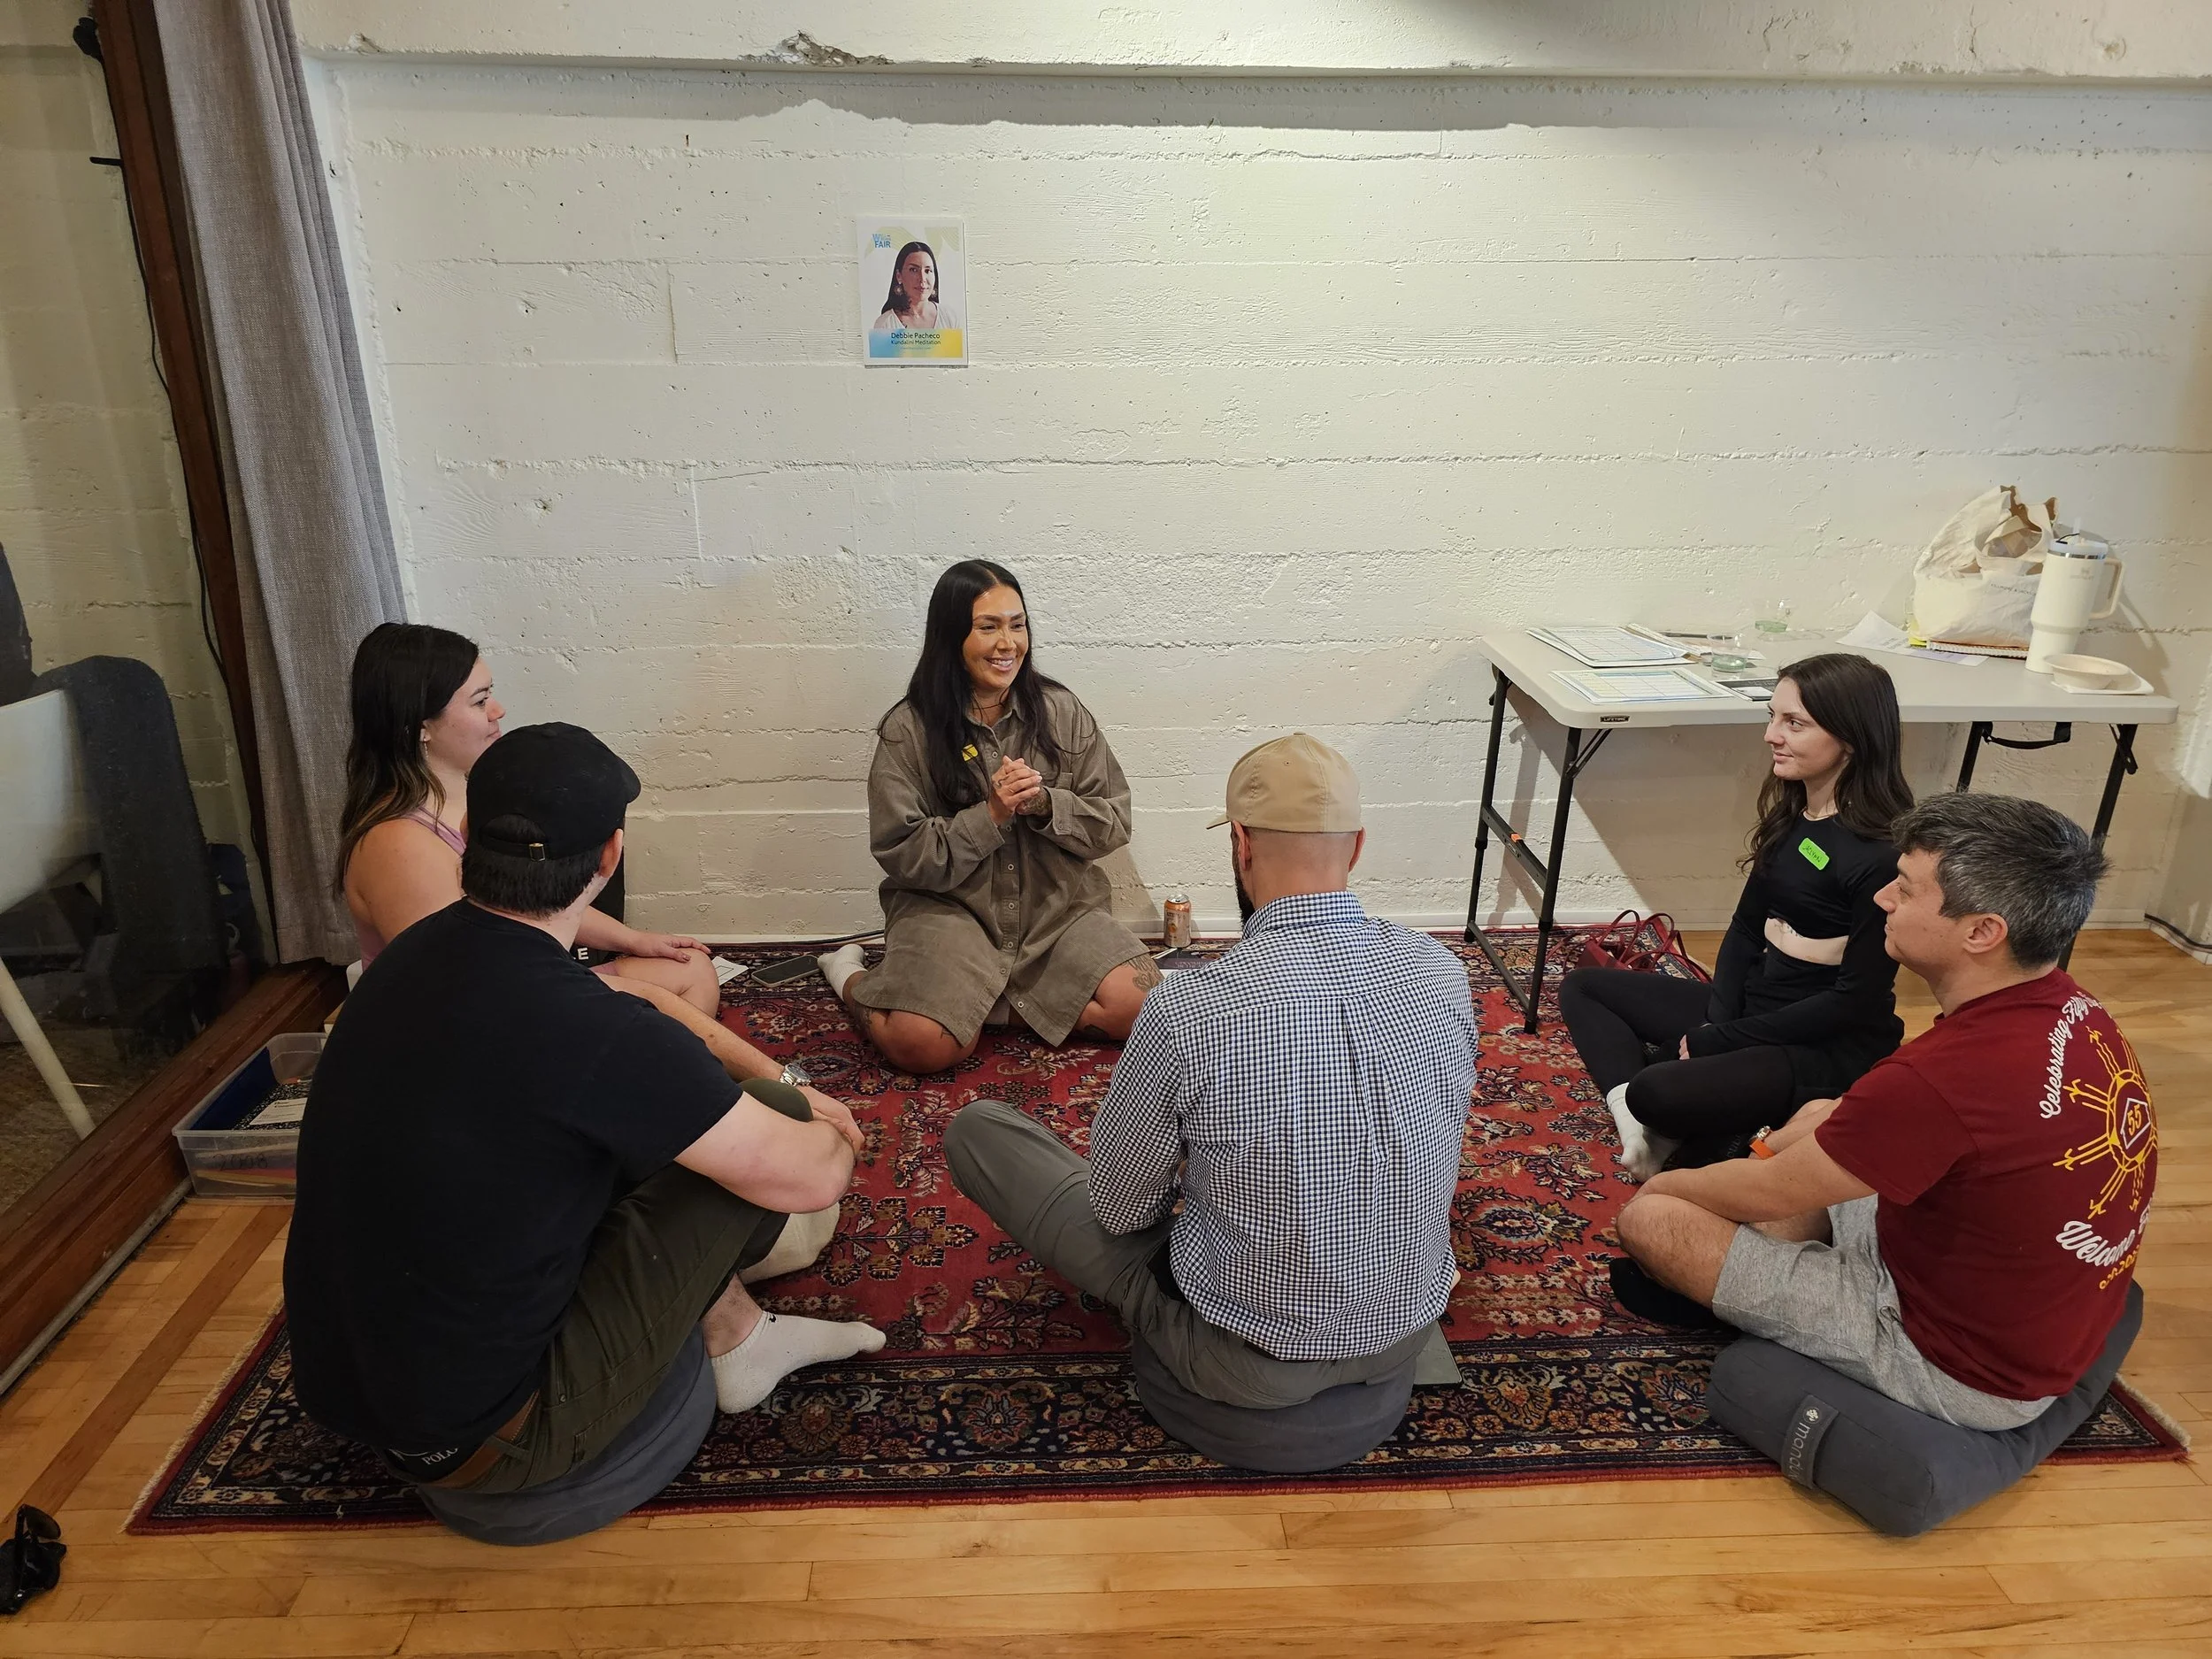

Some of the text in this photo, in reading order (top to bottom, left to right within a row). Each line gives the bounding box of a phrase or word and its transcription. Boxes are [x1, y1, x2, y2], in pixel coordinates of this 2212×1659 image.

[2039, 1018, 2073, 1119] Celebrating
[2127, 1103, 2142, 1136] 55
[2055, 1220, 2136, 1267] Welcome
